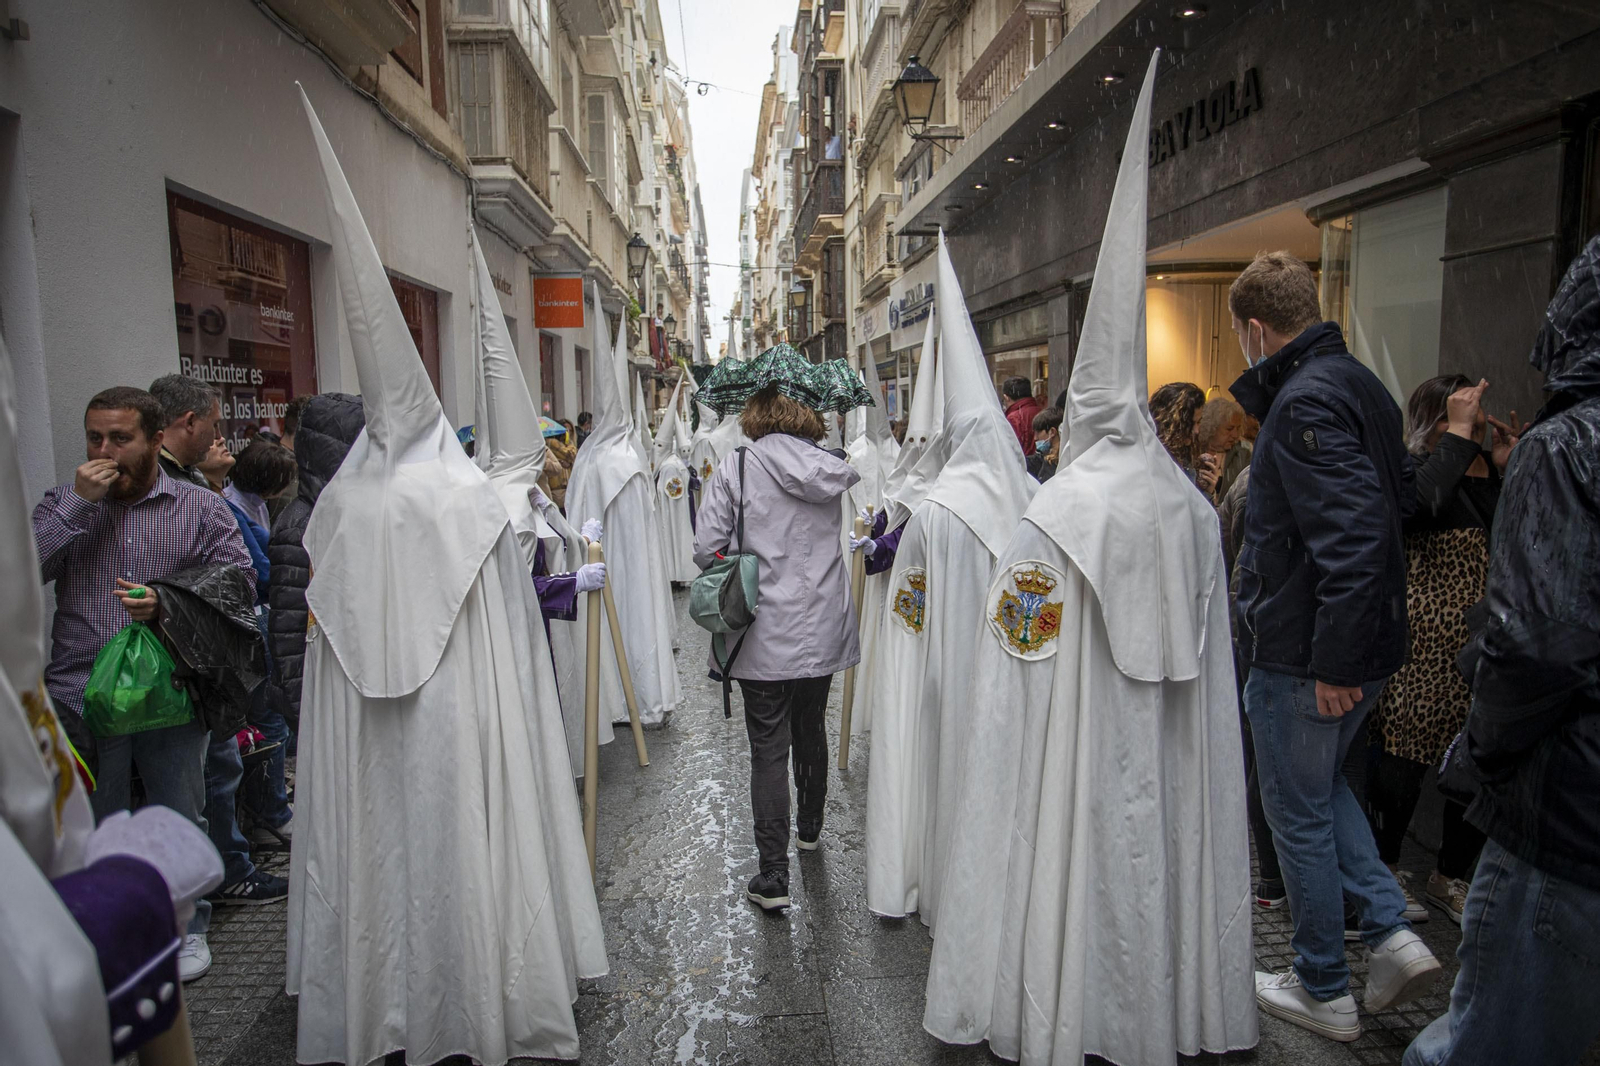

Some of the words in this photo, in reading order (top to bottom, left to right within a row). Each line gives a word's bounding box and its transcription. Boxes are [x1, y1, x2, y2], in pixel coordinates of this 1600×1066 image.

[1195, 67, 1263, 142] LOLA
[181, 356, 248, 384] Bankinter
[250, 368, 264, 385] es
[233, 395, 251, 419] los
